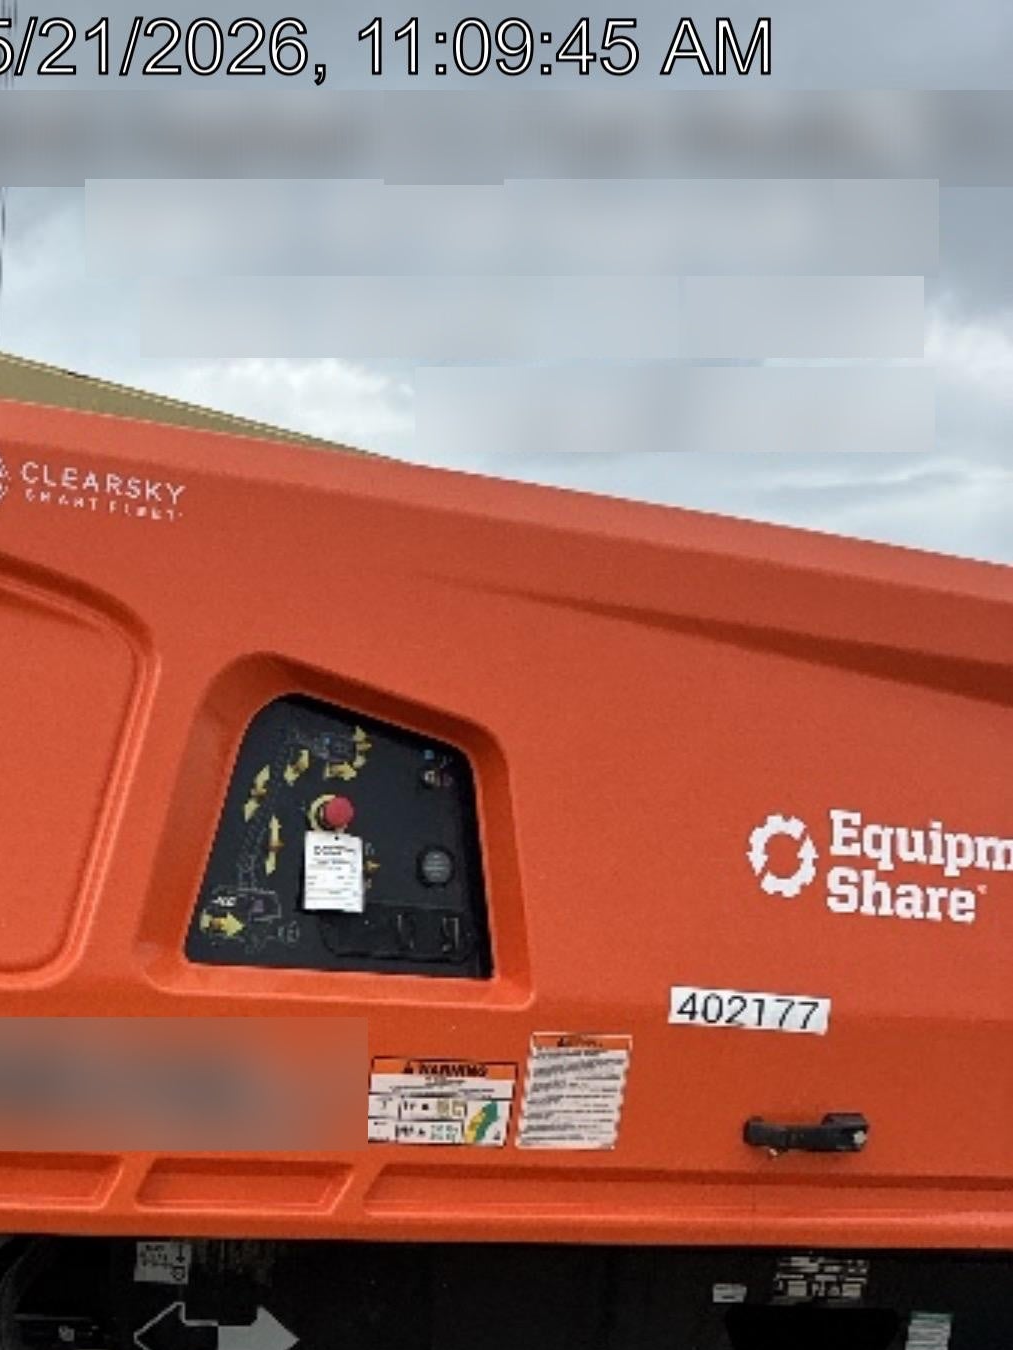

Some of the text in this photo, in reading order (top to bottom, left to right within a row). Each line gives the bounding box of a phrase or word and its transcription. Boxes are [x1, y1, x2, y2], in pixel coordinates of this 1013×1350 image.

[20, 461, 186, 506] CLEARSKY
[829, 808, 1013, 877] Equipm
[826, 866, 977, 923] Share
[676, 992, 820, 1030] 402177
